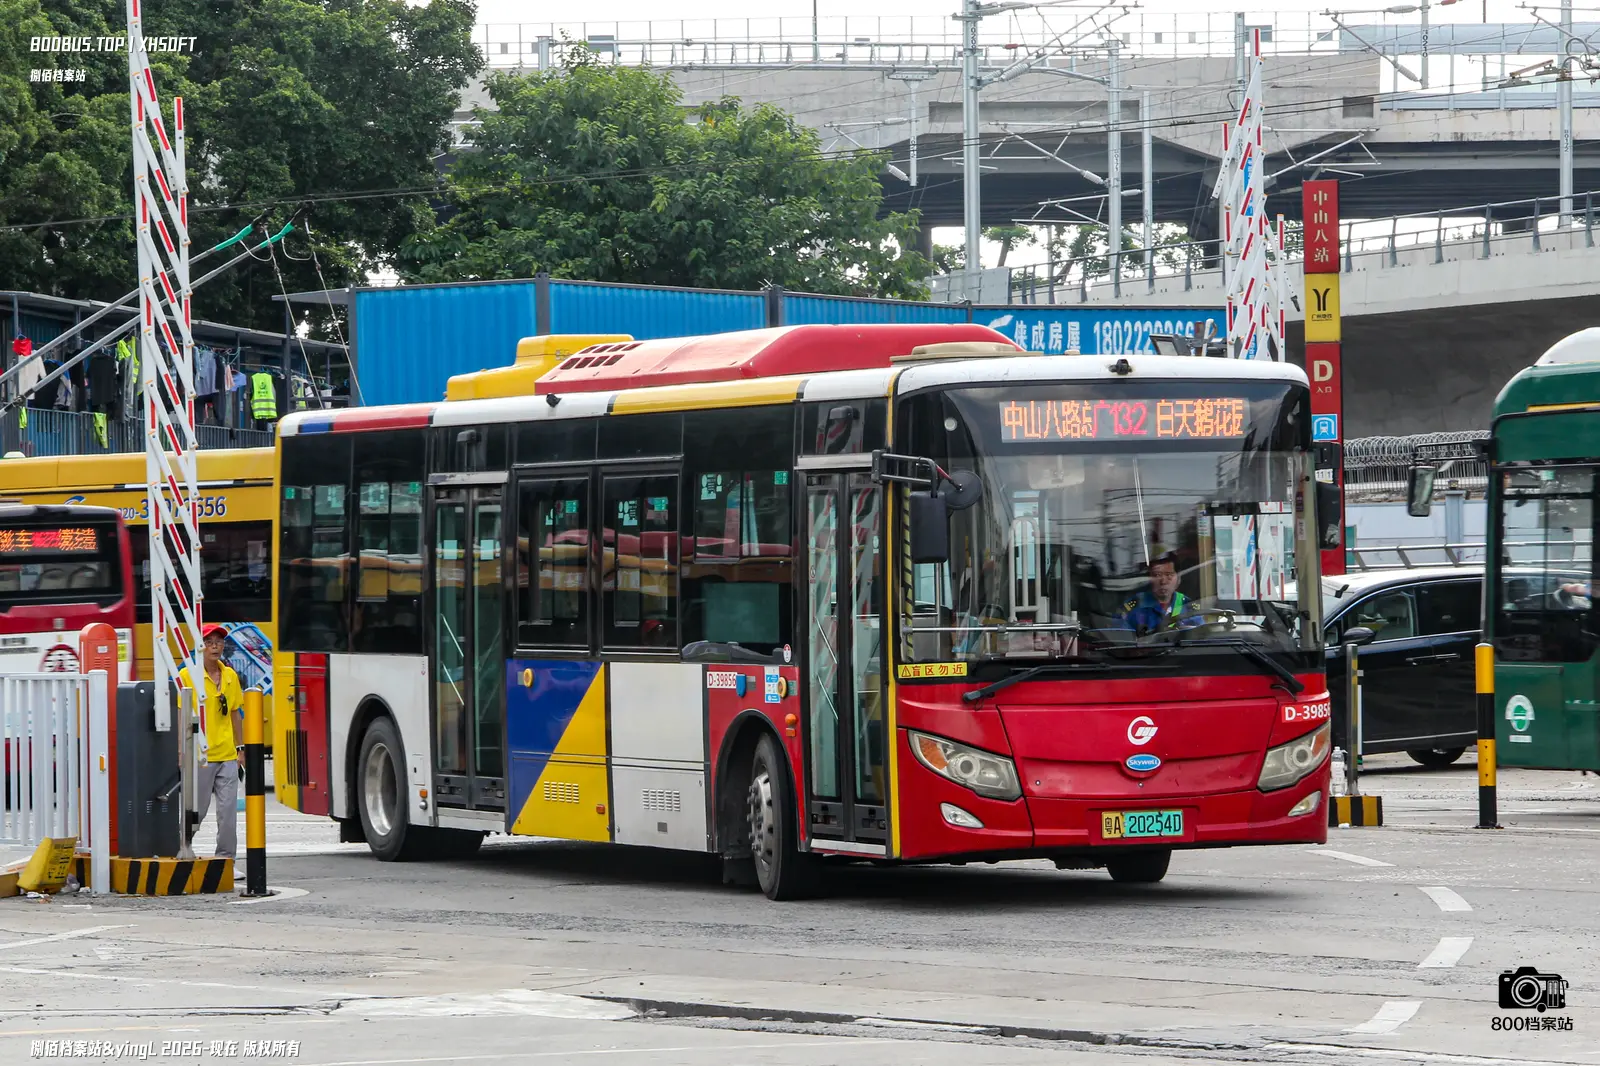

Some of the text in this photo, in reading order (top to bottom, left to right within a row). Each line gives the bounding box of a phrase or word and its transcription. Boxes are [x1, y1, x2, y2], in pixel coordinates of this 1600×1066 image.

[1313, 190, 1330, 264] 中山八站
[1093, 319, 1196, 355] 180222
[1313, 360, 1334, 382] D
[1315, 386, 1333, 394] 入口
[911, 664, 964, 677] 盲区勿近
[1129, 759, 1158, 767] Skywell
[1128, 814, 1182, 834] 20254D
